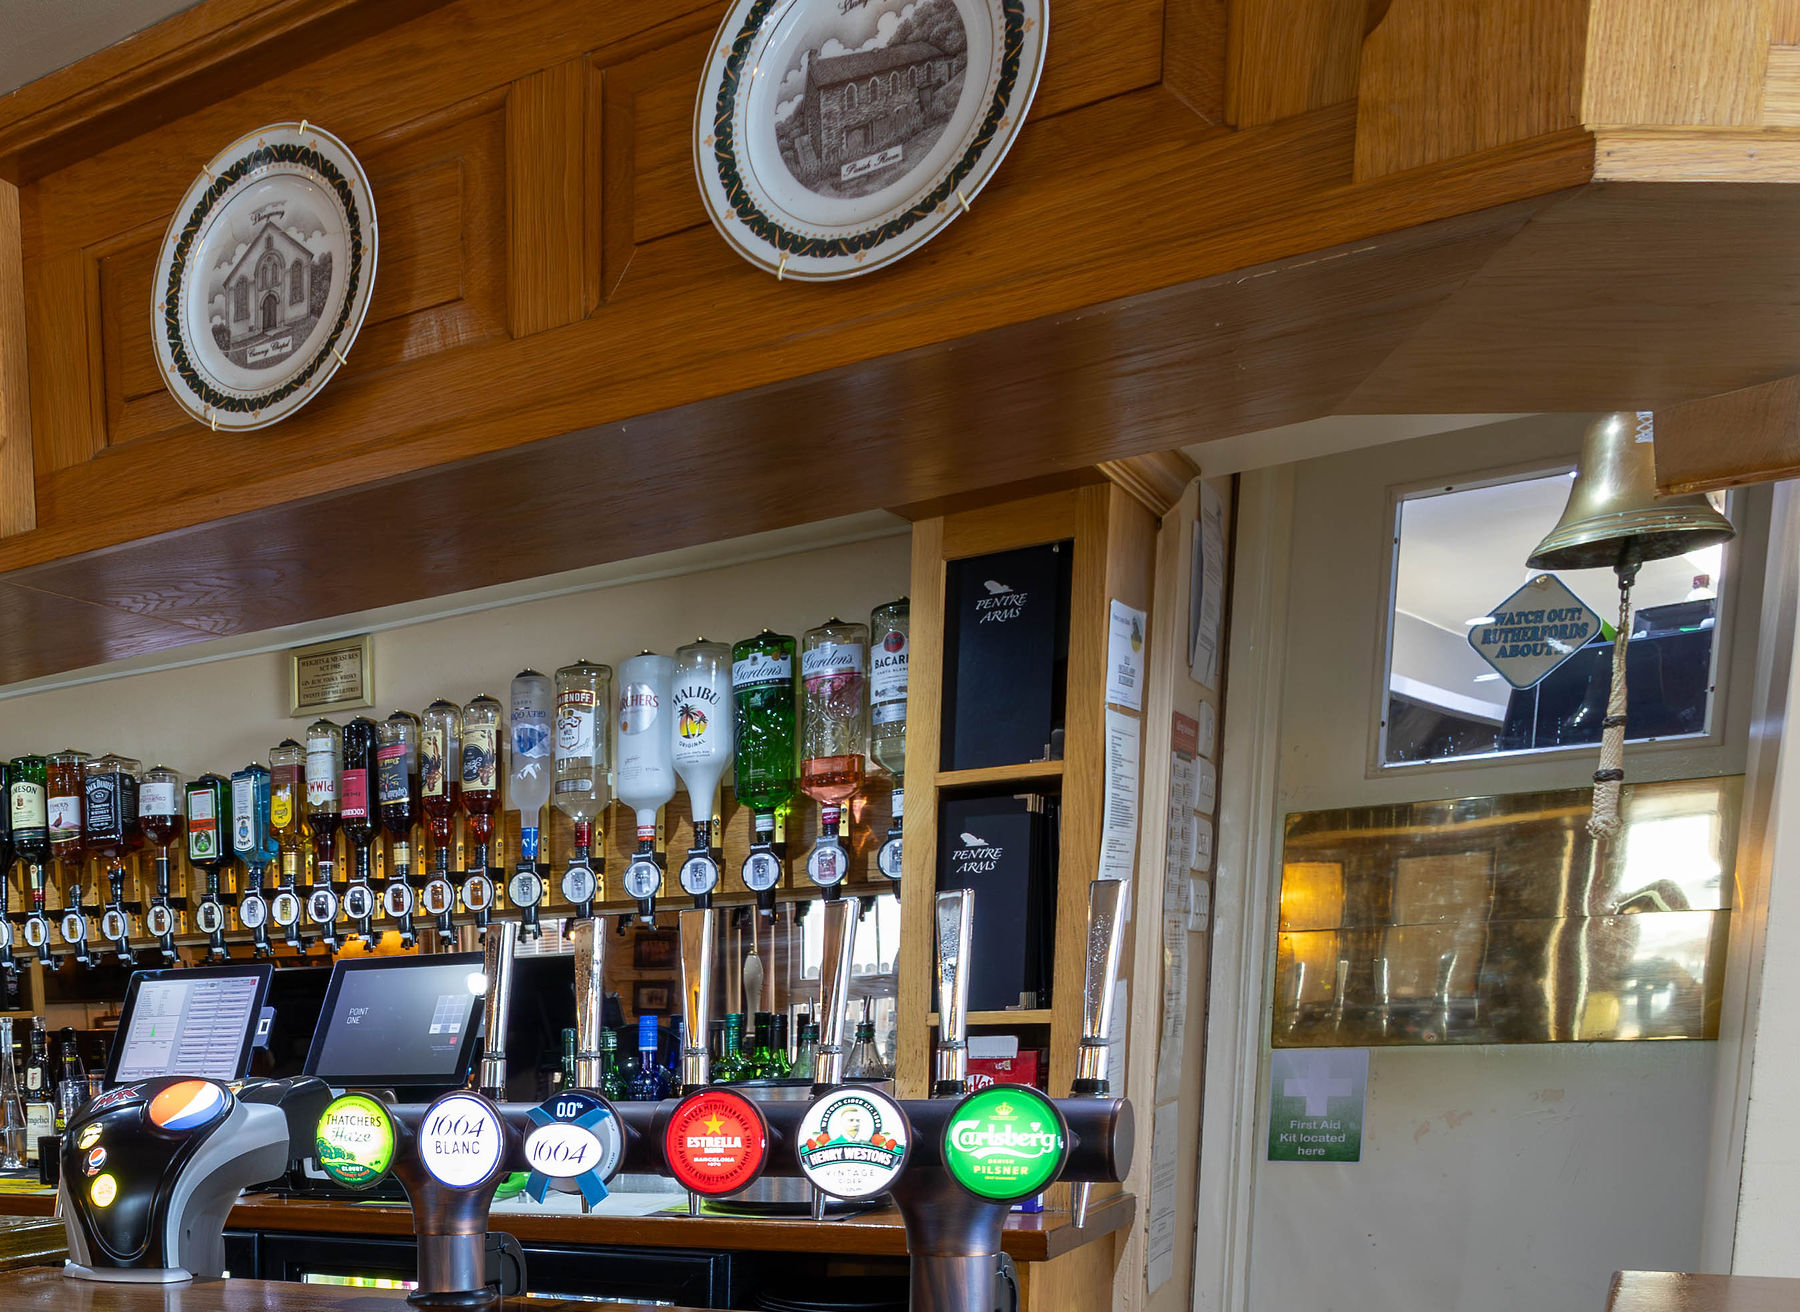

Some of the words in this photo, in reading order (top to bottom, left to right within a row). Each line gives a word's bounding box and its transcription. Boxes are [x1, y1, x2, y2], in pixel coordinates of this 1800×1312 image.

[842, 163, 871, 176] Parish
[873, 151, 899, 168] Room
[976, 593, 1028, 610] PENTRE
[979, 607, 1021, 624] ARMS
[1493, 610, 1545, 627] WATCH
[1547, 607, 1583, 623] OUT!
[1481, 622, 1589, 645] RUTHERFORDS
[804, 650, 853, 671] Gordon's
[734, 659, 782, 681] Gordon's
[672, 685, 721, 709] MALIBU
[679, 738, 707, 748] ORIGINAL
[952, 847, 1003, 861] PENTRE
[956, 860, 997, 874] ARMS
[347, 1016, 361, 1024] ONE
[349, 1007, 370, 1016] POINT
[90, 1082, 148, 1112] MAX
[556, 1101, 584, 1118] 0.0%
[821, 1101, 842, 1128] WESTONS
[843, 1098, 864, 1106] CIDER
[326, 1114, 382, 1128] THATCHERS
[430, 1113, 485, 1138] 1664
[1289, 1120, 1318, 1130] First
[1319, 1120, 1342, 1130] Aid
[332, 1127, 372, 1142] Haze
[686, 1136, 743, 1149] ESTRELLA
[951, 1119, 1057, 1154] Carlsberg
[1280, 1132, 1298, 1143] Kit
[1300, 1132, 1347, 1143] located
[435, 1140, 480, 1155] BLANC
[533, 1140, 588, 1164] 1664
[1297, 1146, 1326, 1156] here
[809, 1147, 843, 1167] HENRY
[844, 1146, 894, 1166] WESTONS
[826, 1168, 876, 1178] VINTAGE
[973, 1165, 1029, 1176] PILSNER
